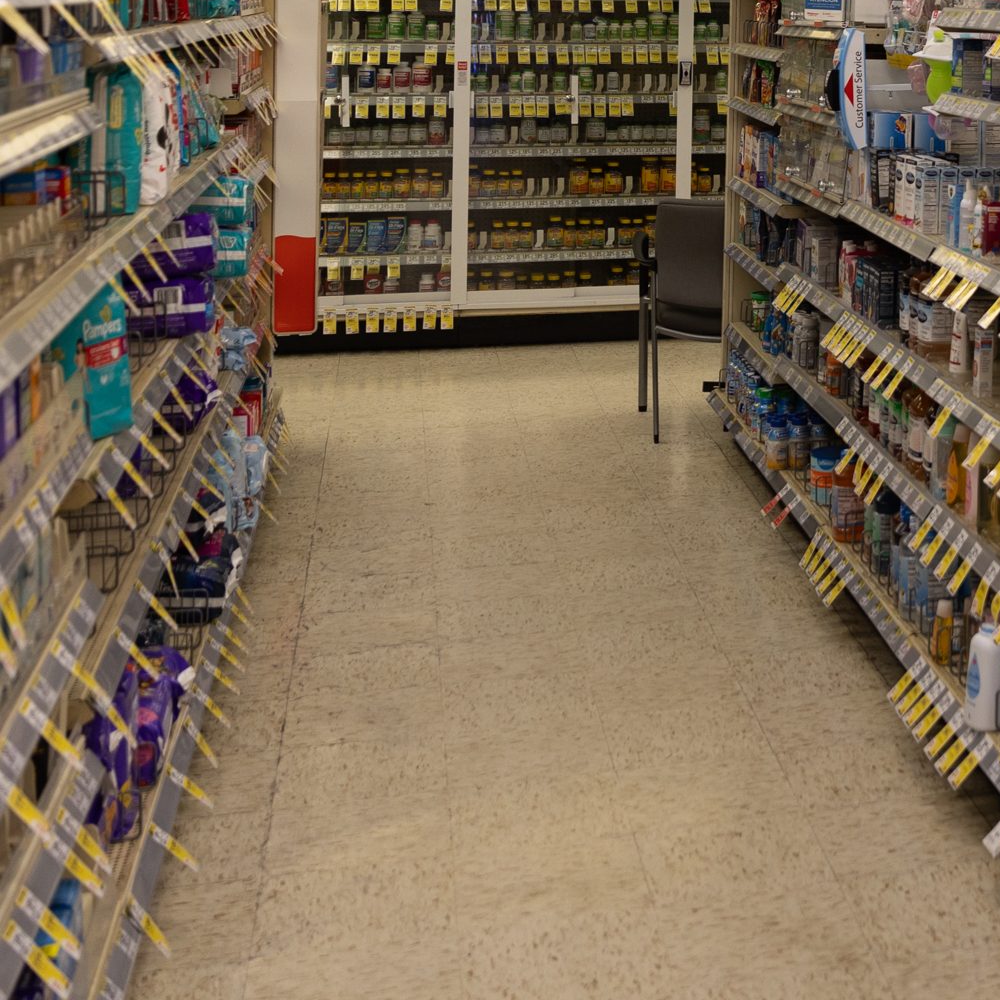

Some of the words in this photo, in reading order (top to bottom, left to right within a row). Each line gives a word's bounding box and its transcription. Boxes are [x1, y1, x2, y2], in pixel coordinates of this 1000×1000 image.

[854, 51, 863, 83] Service
[855, 85, 864, 129] Customer
[83, 318, 122, 342] Pampers
